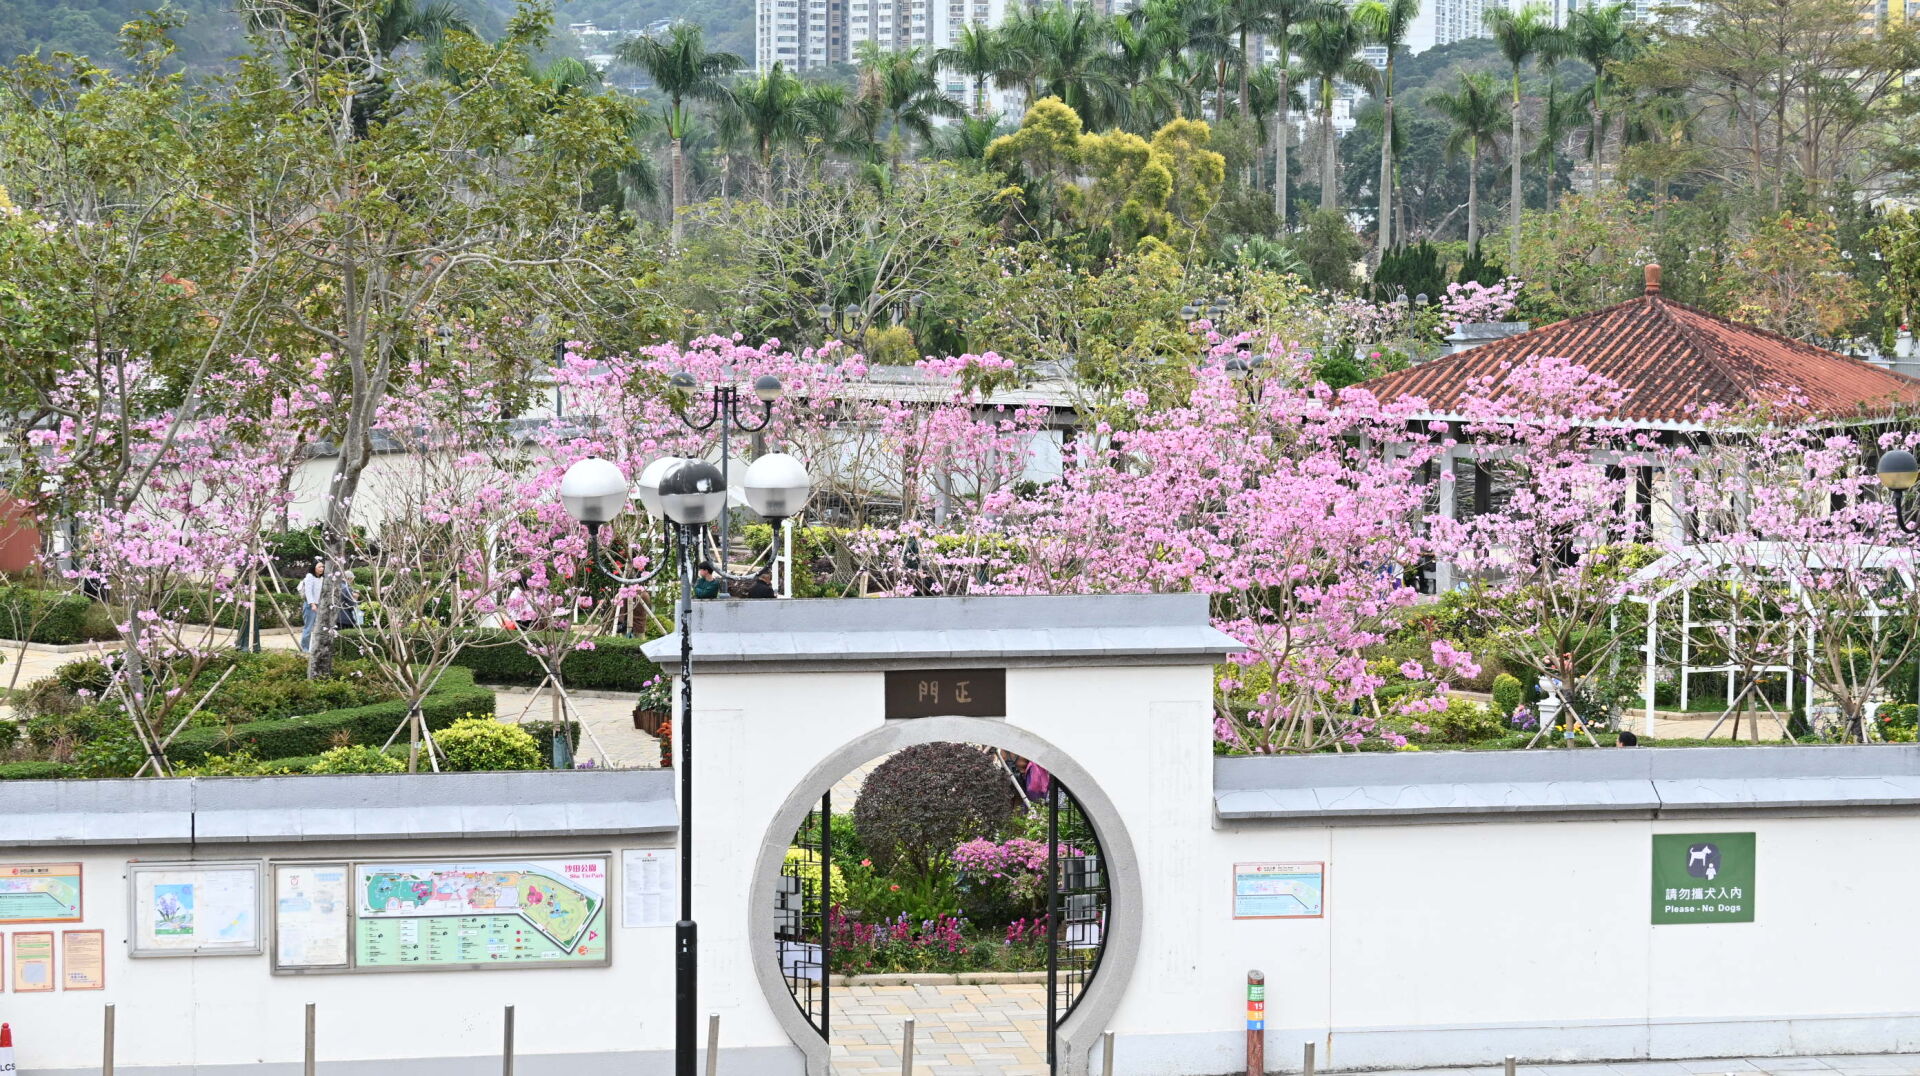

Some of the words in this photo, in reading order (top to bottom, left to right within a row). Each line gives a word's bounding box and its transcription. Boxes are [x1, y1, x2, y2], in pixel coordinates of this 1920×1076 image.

[1665, 905, 1695, 913] Please
[1702, 904, 1714, 912] No
[1718, 904, 1741, 913] Dogs
